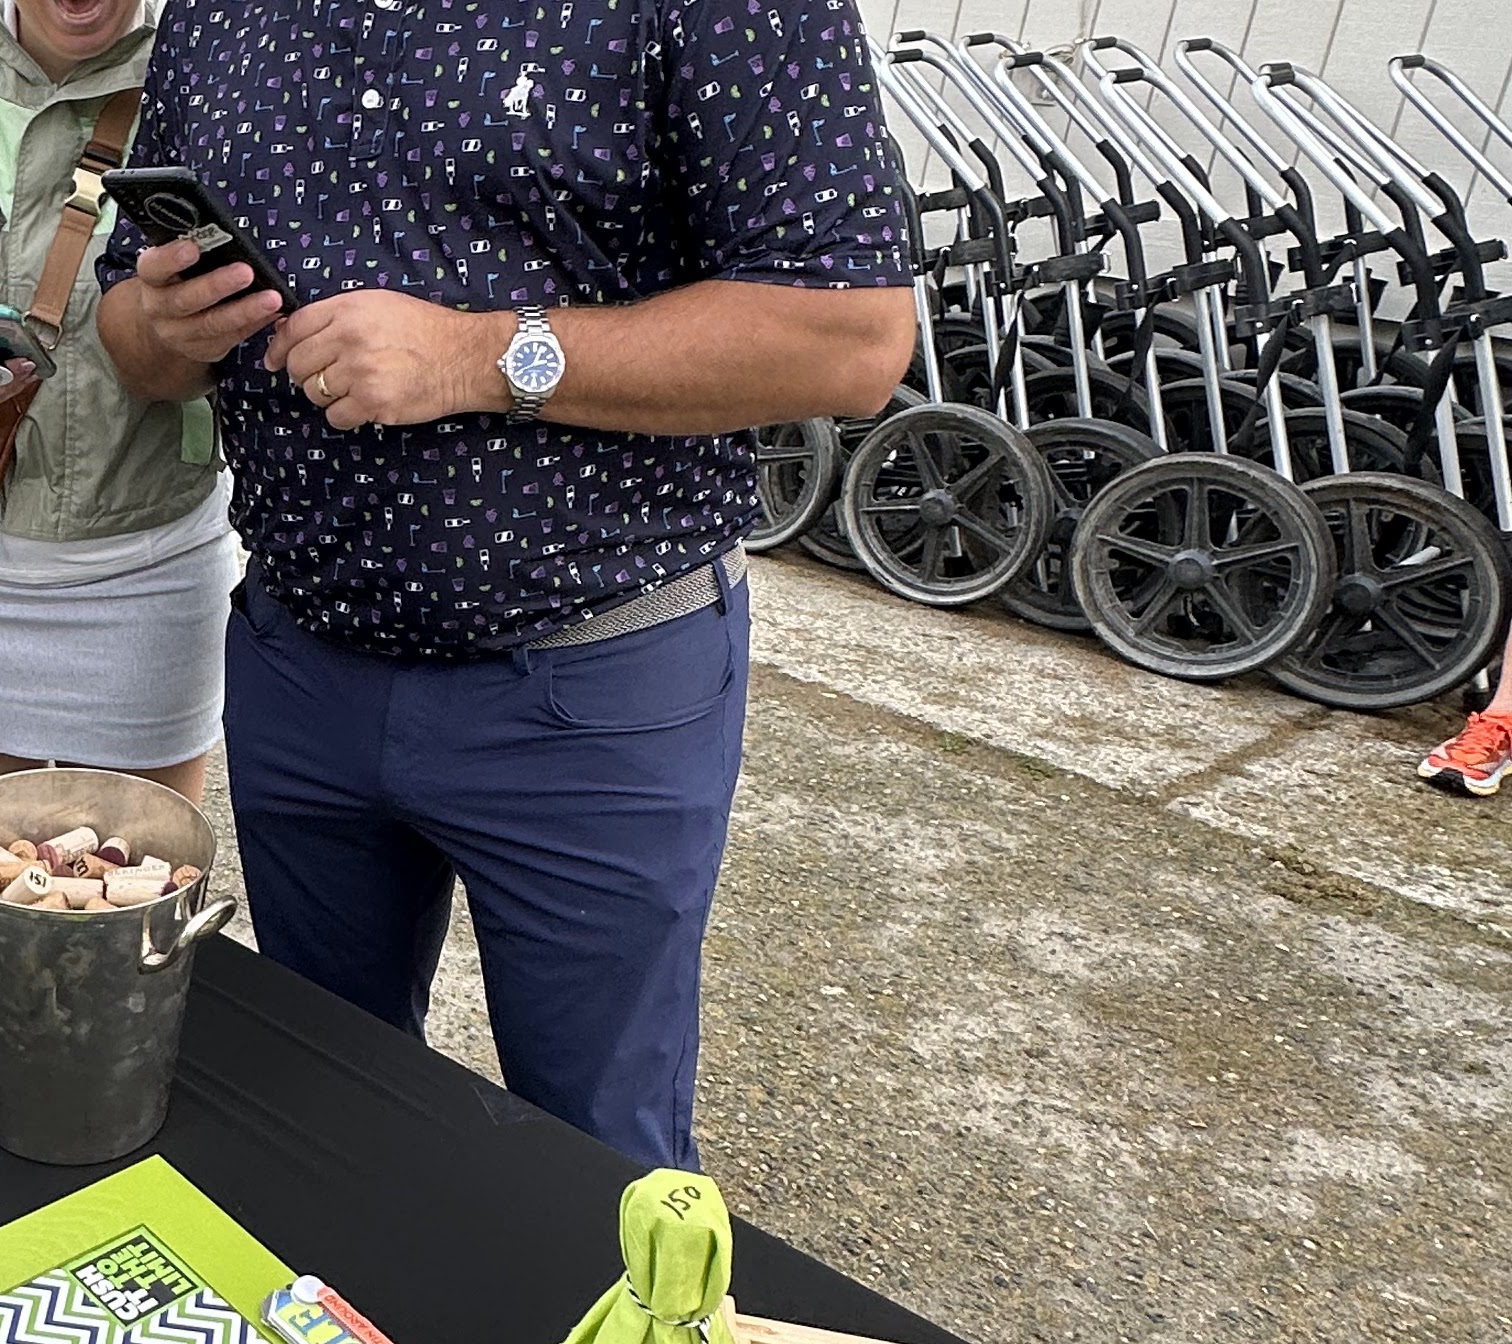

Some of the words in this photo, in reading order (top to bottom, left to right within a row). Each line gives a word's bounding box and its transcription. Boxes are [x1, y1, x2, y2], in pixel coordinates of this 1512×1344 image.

[660, 1186, 702, 1220] 150
[96, 1258, 136, 1290] TO
[112, 1248, 160, 1290] THE
[131, 1242, 193, 1295] LIMIT
[76, 1264, 139, 1320] CUSH
[124, 1288, 158, 1313] IT
